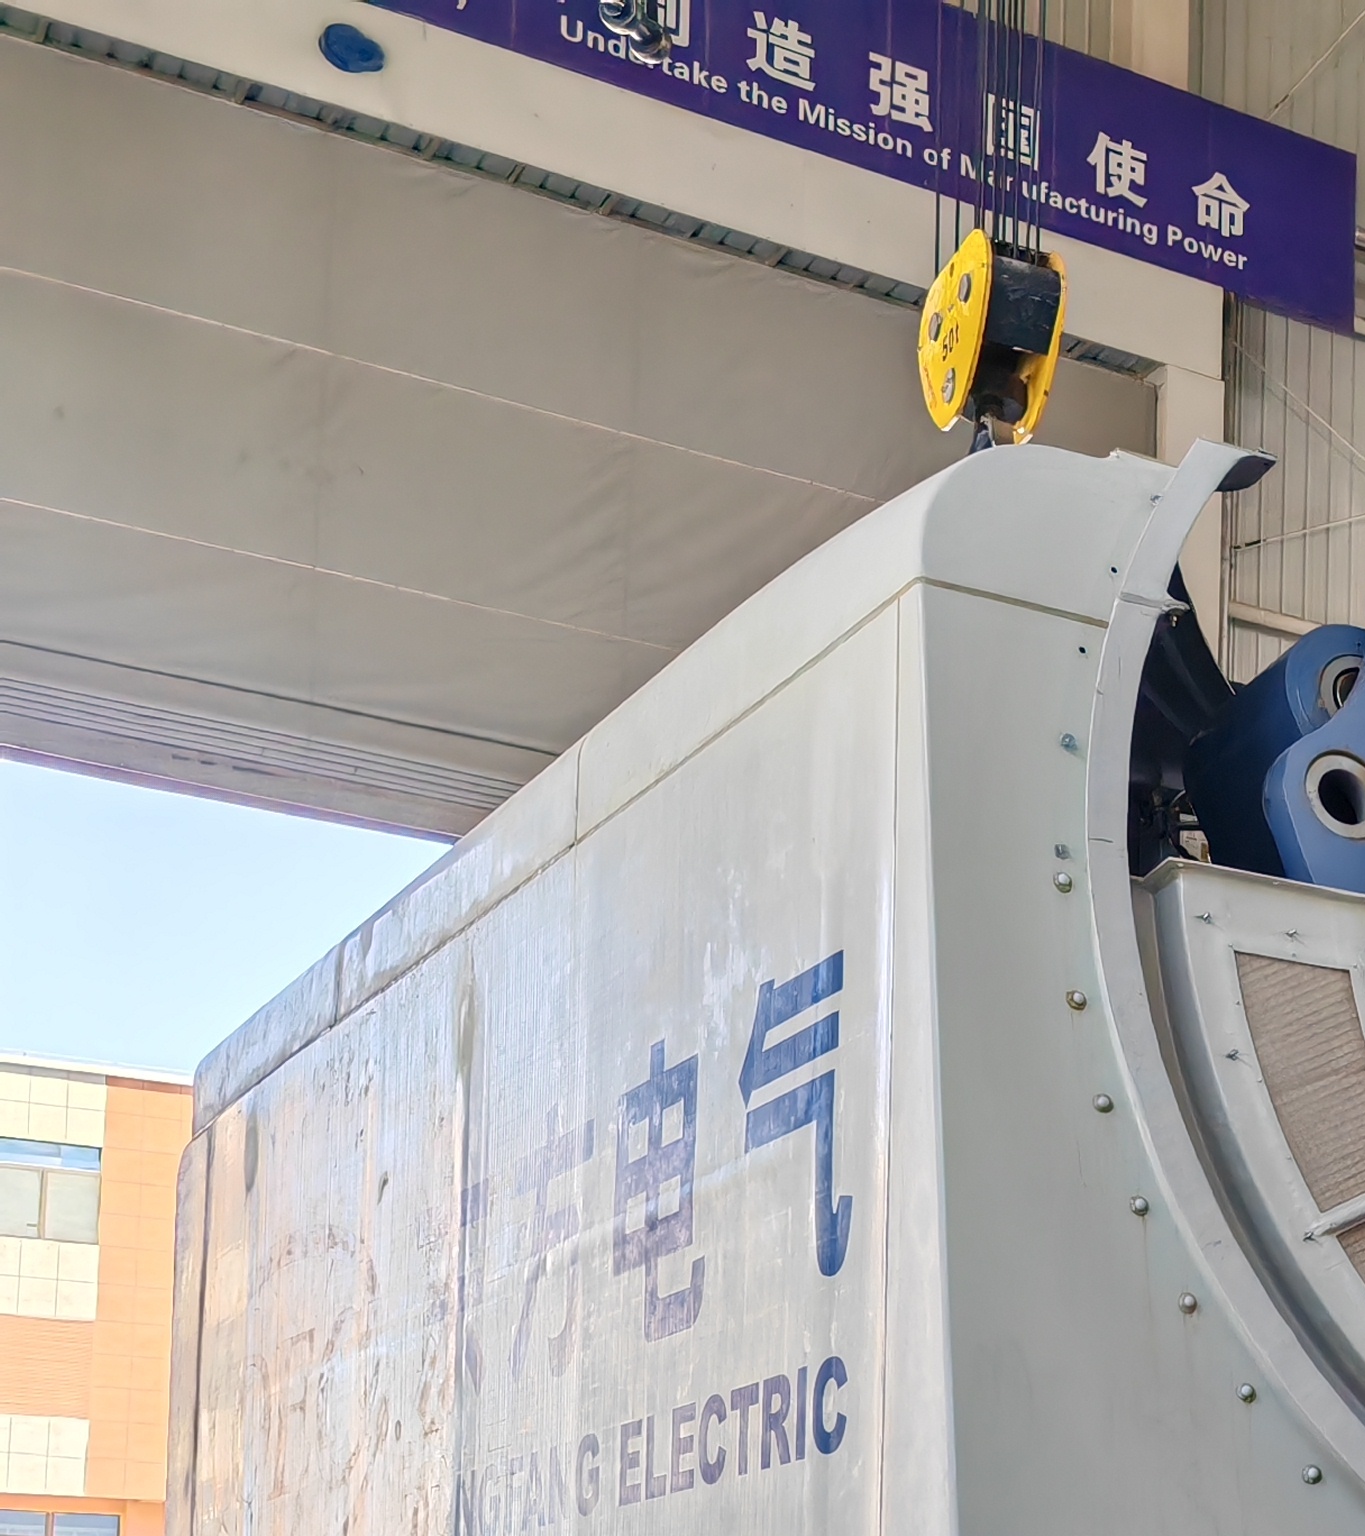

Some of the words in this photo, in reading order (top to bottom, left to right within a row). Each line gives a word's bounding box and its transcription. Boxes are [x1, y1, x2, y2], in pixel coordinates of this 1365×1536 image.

[560, 14, 729, 95] Undtake
[737, 79, 788, 115] the
[798, 97, 913, 159] Mission
[923, 146, 952, 170] of
[1167, 223, 1249, 271] Power
[617, 1355, 849, 1508] ELECTRIC
